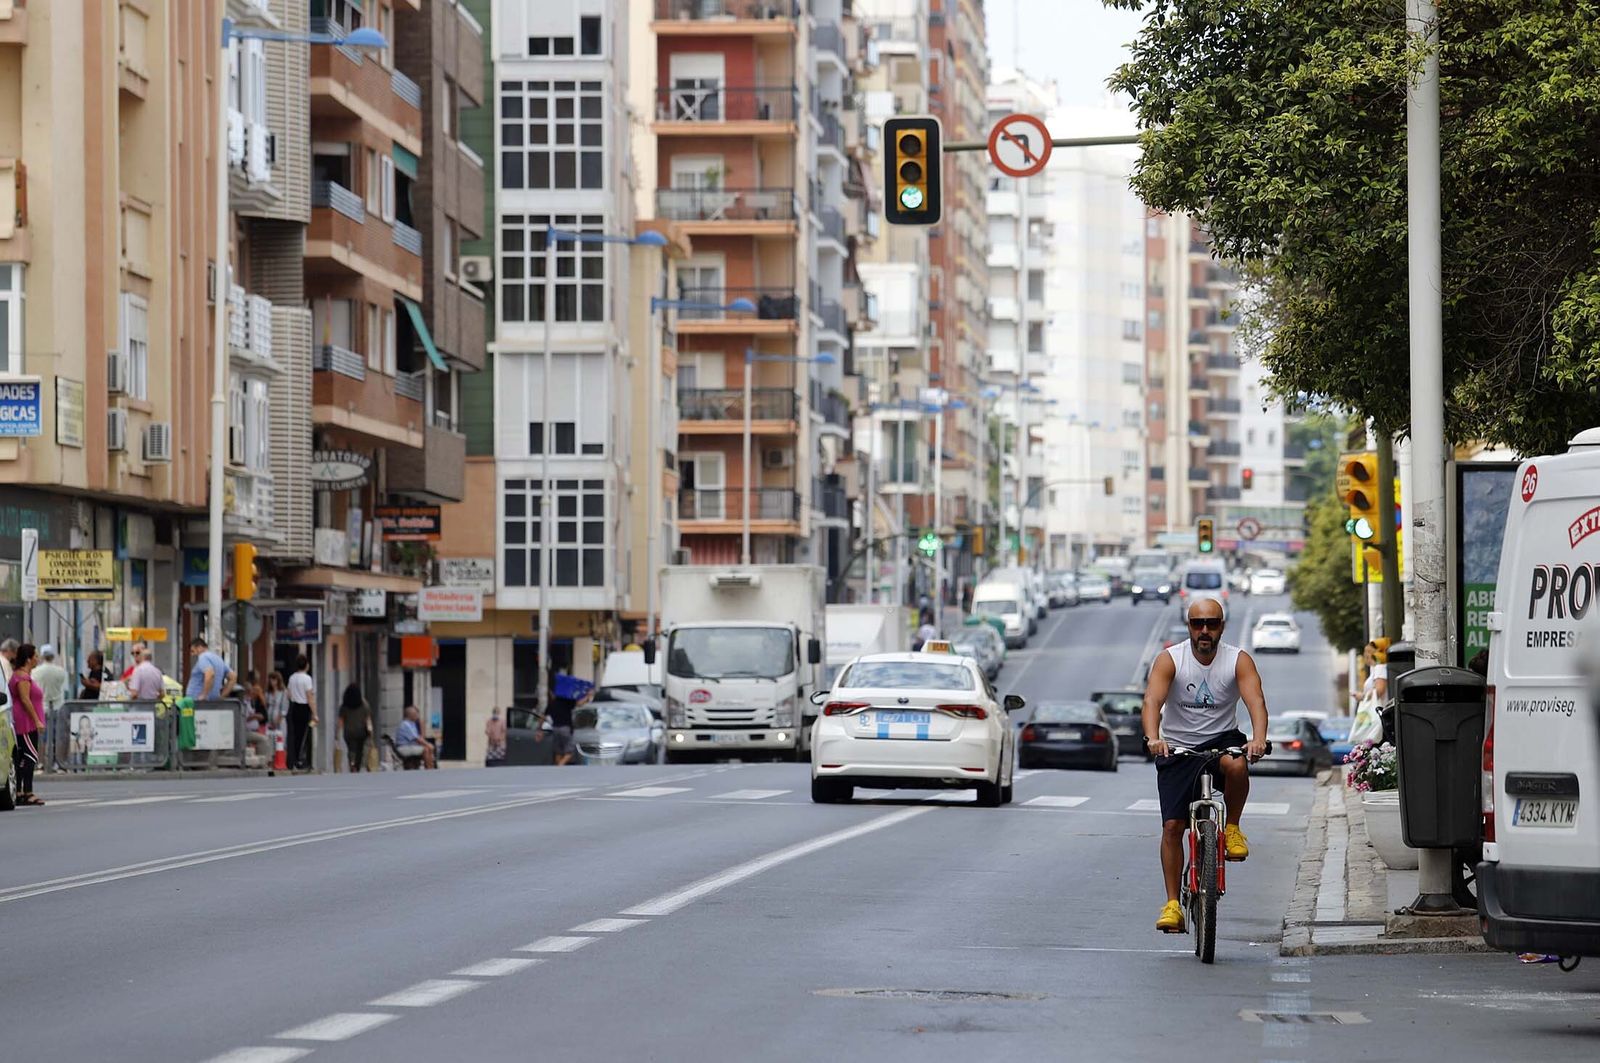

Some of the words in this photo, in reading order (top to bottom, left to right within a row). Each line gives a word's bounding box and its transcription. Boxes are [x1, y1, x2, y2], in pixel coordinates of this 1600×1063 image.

[0, 384, 35, 401] ADES
[313, 450, 370, 469] ORATORIO
[1522, 473, 1537, 495] 26
[1571, 507, 1600, 547] EXT
[1528, 562, 1600, 620] PRO
[1526, 631, 1576, 648] EMPRES
[1520, 802, 1547, 823] 4334
[1550, 802, 1576, 824] KYM
